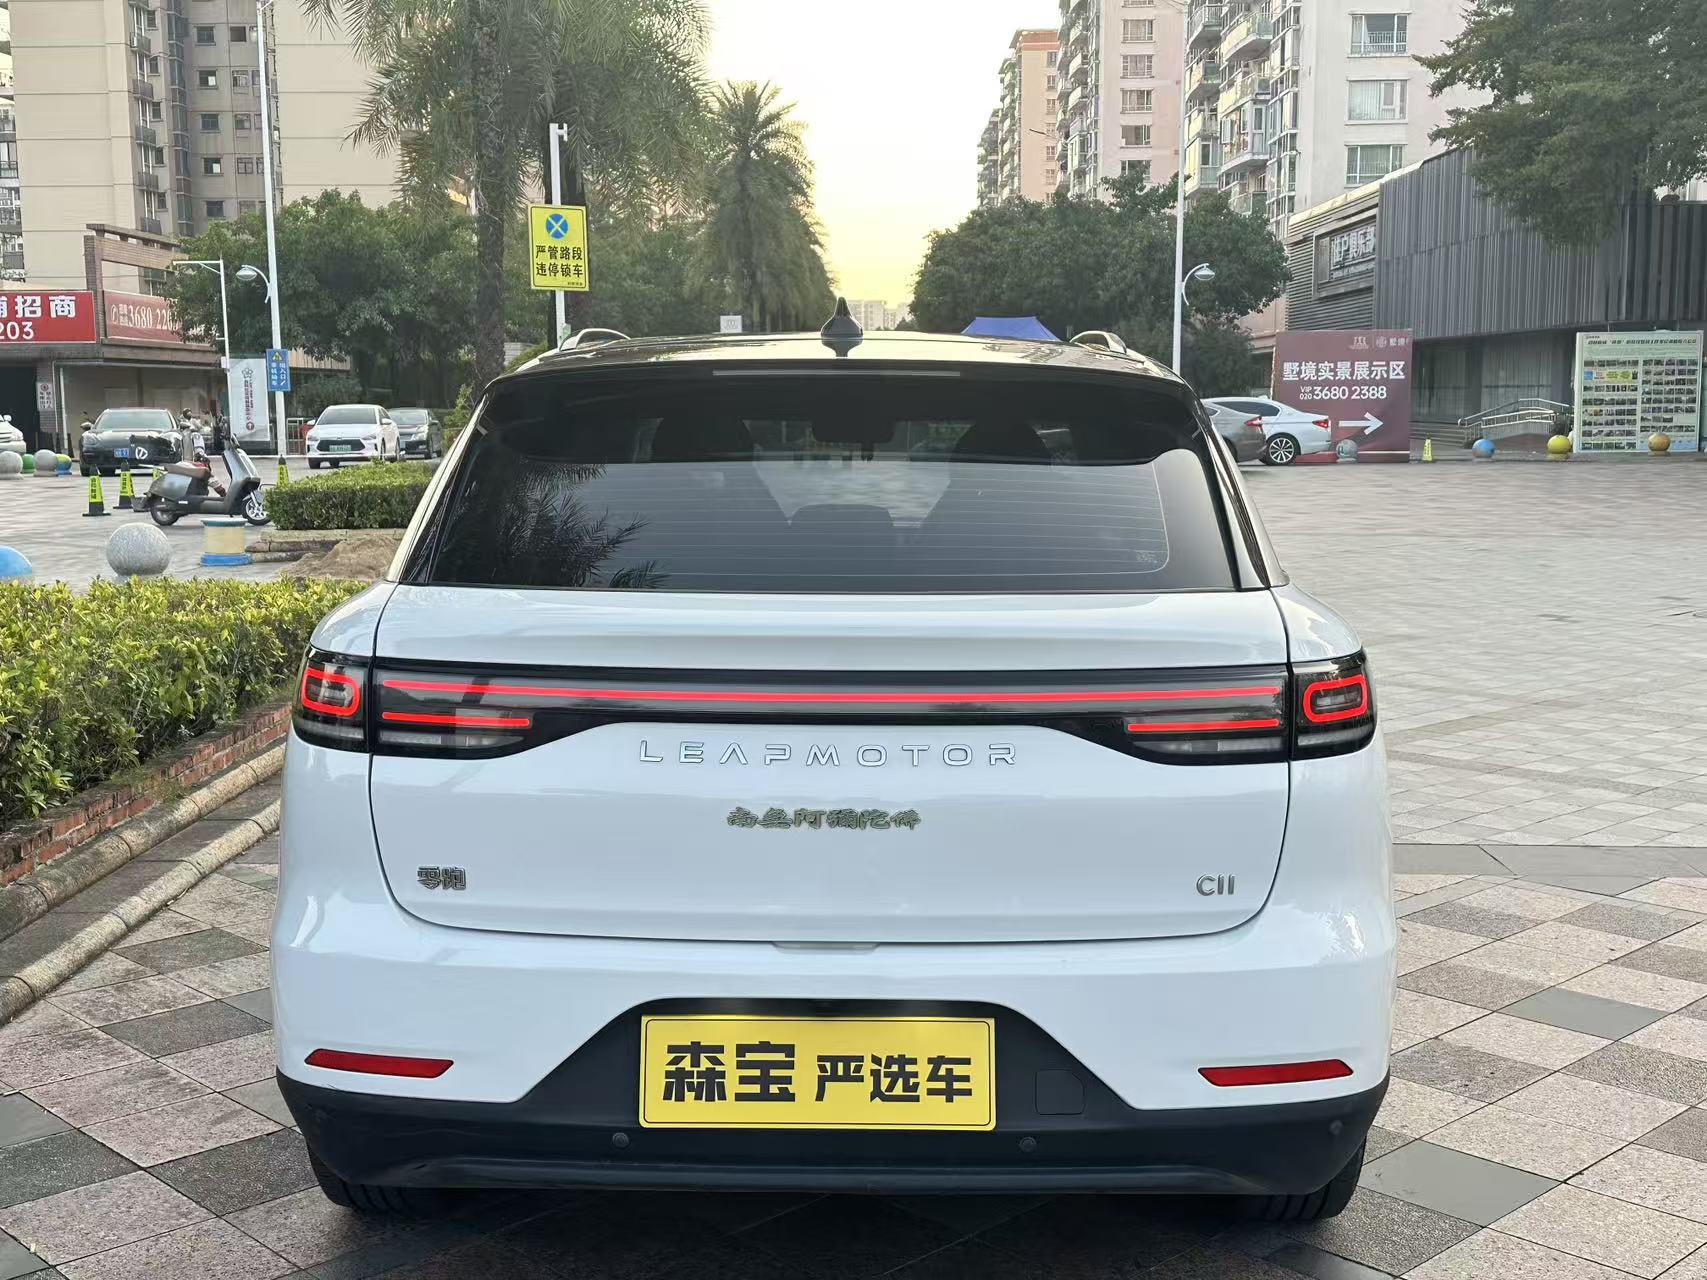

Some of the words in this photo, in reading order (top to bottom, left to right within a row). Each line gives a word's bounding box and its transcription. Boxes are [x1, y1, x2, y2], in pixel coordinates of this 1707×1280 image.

[535, 245, 583, 261] 严管路段
[535, 262, 584, 278] 违停锁车
[0, 295, 76, 318] 招商
[128, 305, 152, 329] 3680
[1282, 360, 1406, 380] 墅境实景展示区
[1313, 385, 1349, 400] 3680
[1351, 385, 1387, 399] 2388
[639, 740, 1017, 767] LEAPMOTOR
[417, 866, 466, 890] 零跑
[1196, 874, 1235, 896] C11
[662, 1041, 796, 1102] 森宝
[815, 1054, 973, 1103] 严选车
